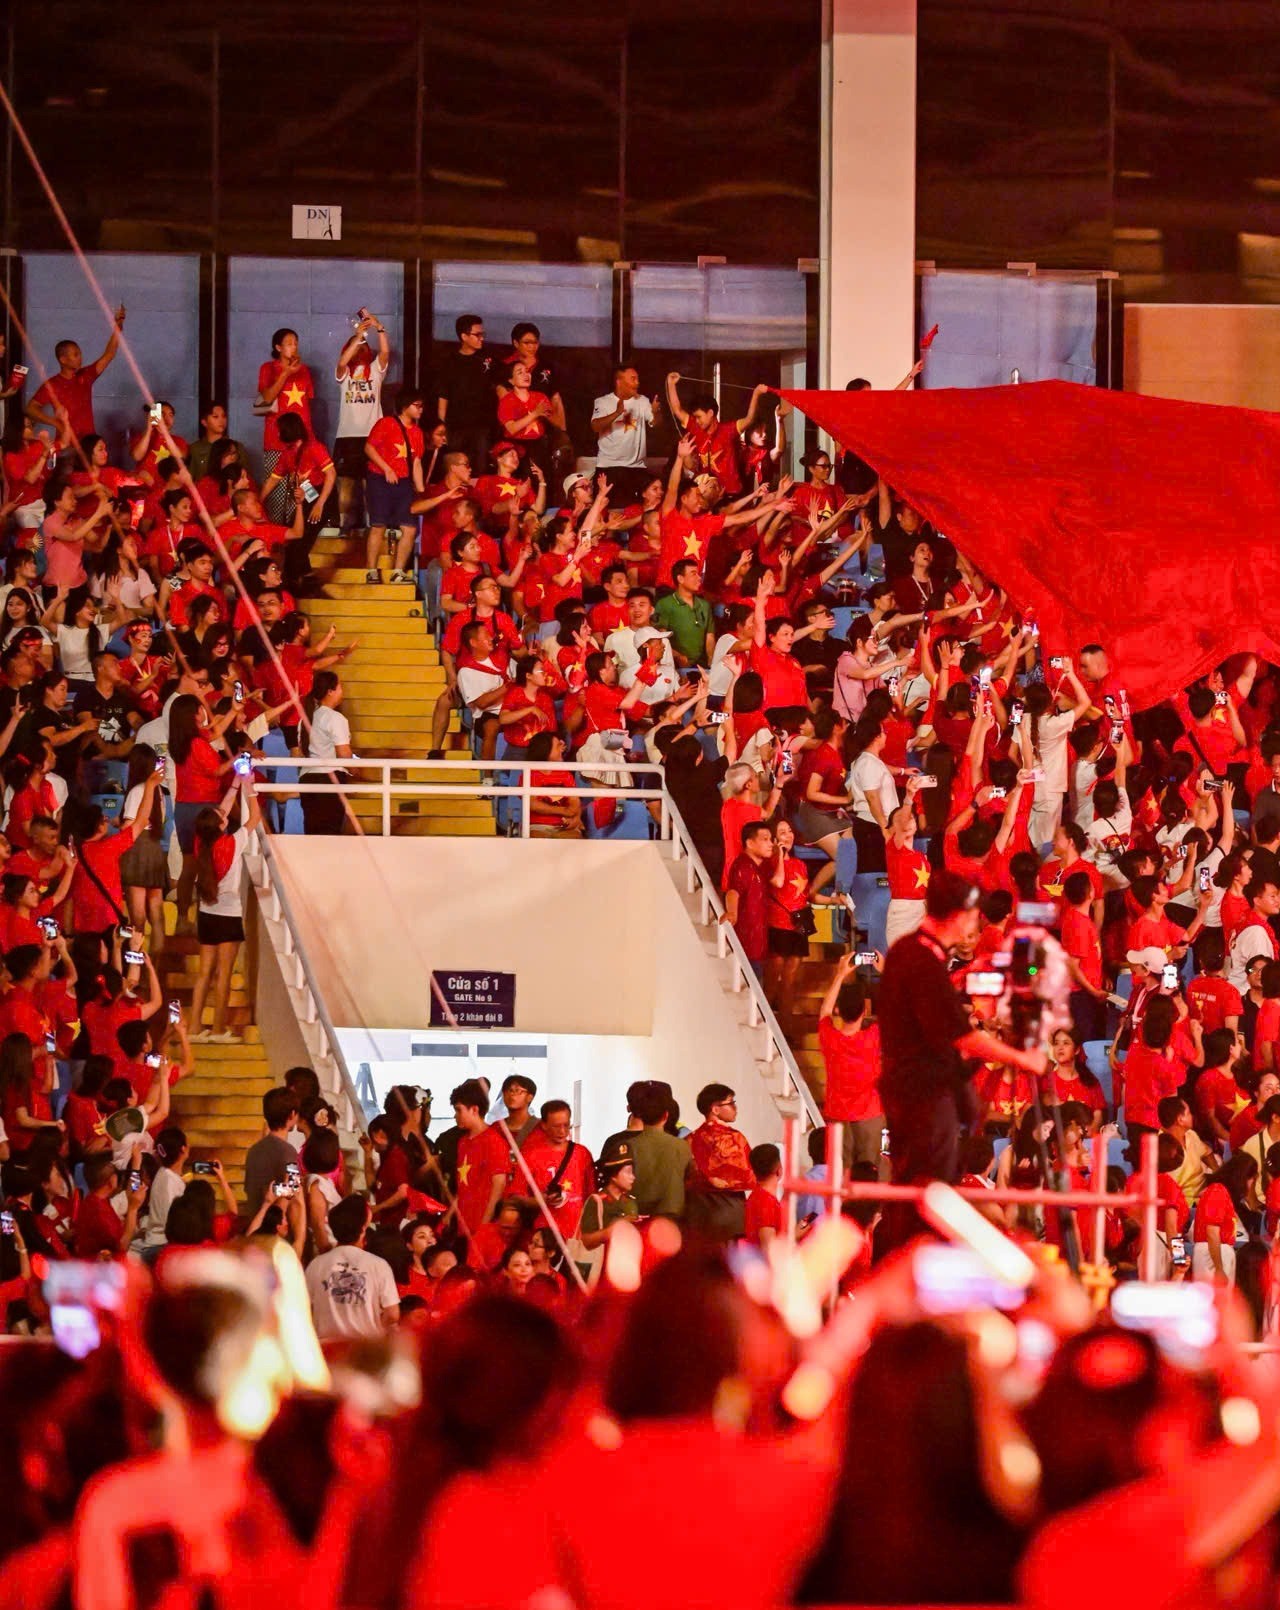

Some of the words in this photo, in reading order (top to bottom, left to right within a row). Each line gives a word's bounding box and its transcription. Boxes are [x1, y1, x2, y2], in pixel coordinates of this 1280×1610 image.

[345, 391, 376, 403] NAM
[448, 975, 471, 990] Cửa
[475, 976, 490, 990] số
[493, 978, 499, 991] 1
[454, 993, 473, 1002] GATE
[475, 994, 485, 1002] No
[460, 1013, 465, 1021] 2
